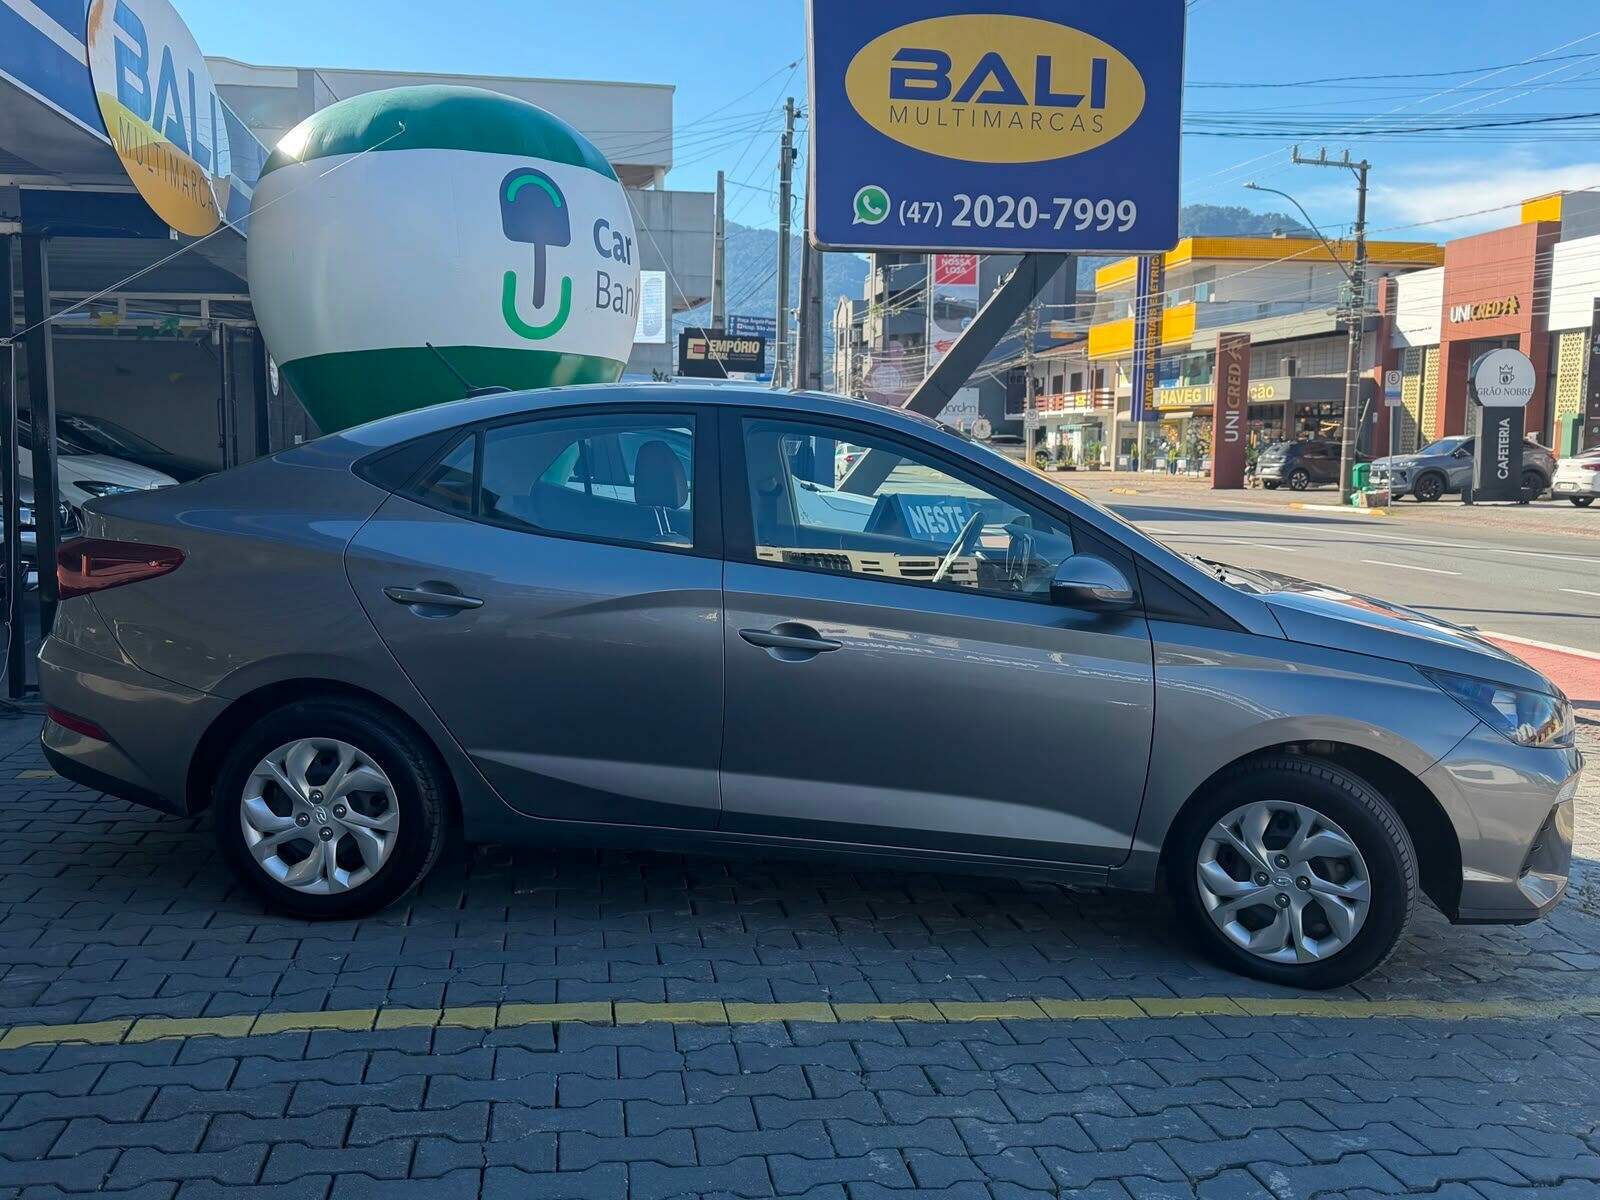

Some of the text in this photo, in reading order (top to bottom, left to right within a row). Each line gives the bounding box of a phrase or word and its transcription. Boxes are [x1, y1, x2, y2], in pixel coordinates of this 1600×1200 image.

[113, 0, 219, 178] BALI
[889, 47, 1108, 109] BALI
[889, 105, 1104, 133] MULTIMARCAS
[119, 115, 216, 212] MULTIMARCA
[899, 194, 1137, 232] (47) 2020-7999
[593, 218, 632, 265] Car
[941, 258, 971, 266] NOSSA
[1450, 301, 1502, 323] UNICRED
[709, 338, 760, 354] EMPÓRIO
[1144, 255, 1160, 410] HAVEG MATERIAIS ELÉTRIC
[1160, 388, 1201, 405] HAVEG
[1224, 363, 1241, 442] UNICRED
[1477, 387, 1532, 396] GRÃO NOBRE
[1497, 418, 1510, 479] CAFETERIA
[908, 505, 966, 534] NESTE
